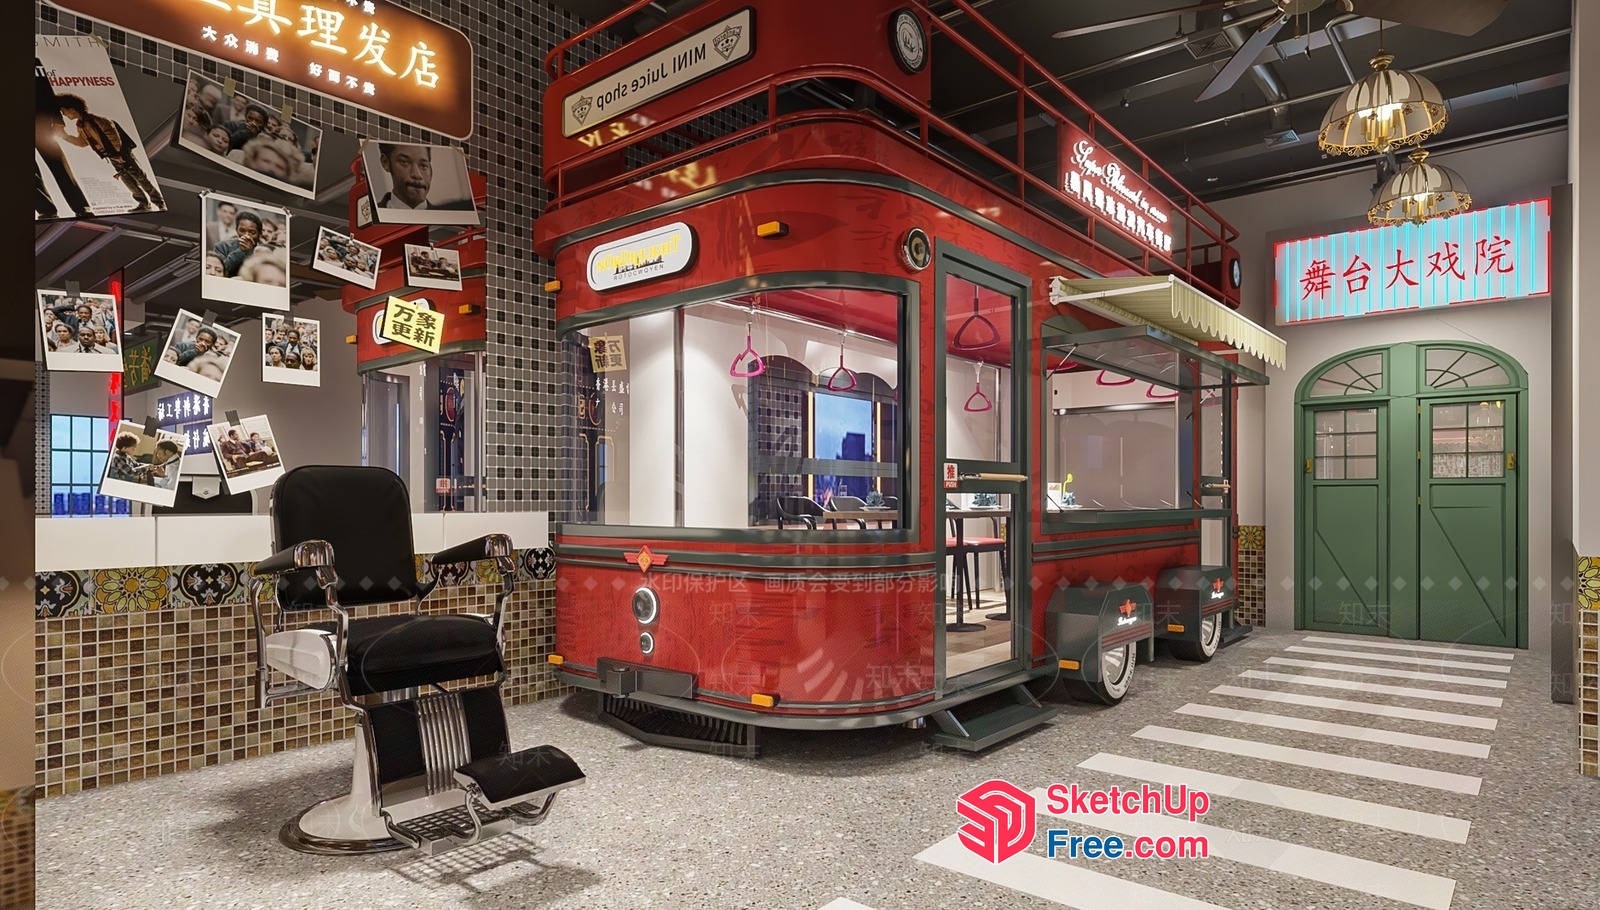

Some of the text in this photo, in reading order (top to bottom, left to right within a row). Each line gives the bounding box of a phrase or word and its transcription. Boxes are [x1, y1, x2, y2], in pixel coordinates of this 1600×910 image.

[200, 0, 440, 89] 真理发店
[47, 69, 56, 77] of
[49, 76, 115, 87] HAPPYNESS
[1299, 235, 1515, 301] 舞台大戏院
[393, 304, 437, 331] 万象
[392, 319, 436, 347] 更新
[946, 464, 956, 479] 推
